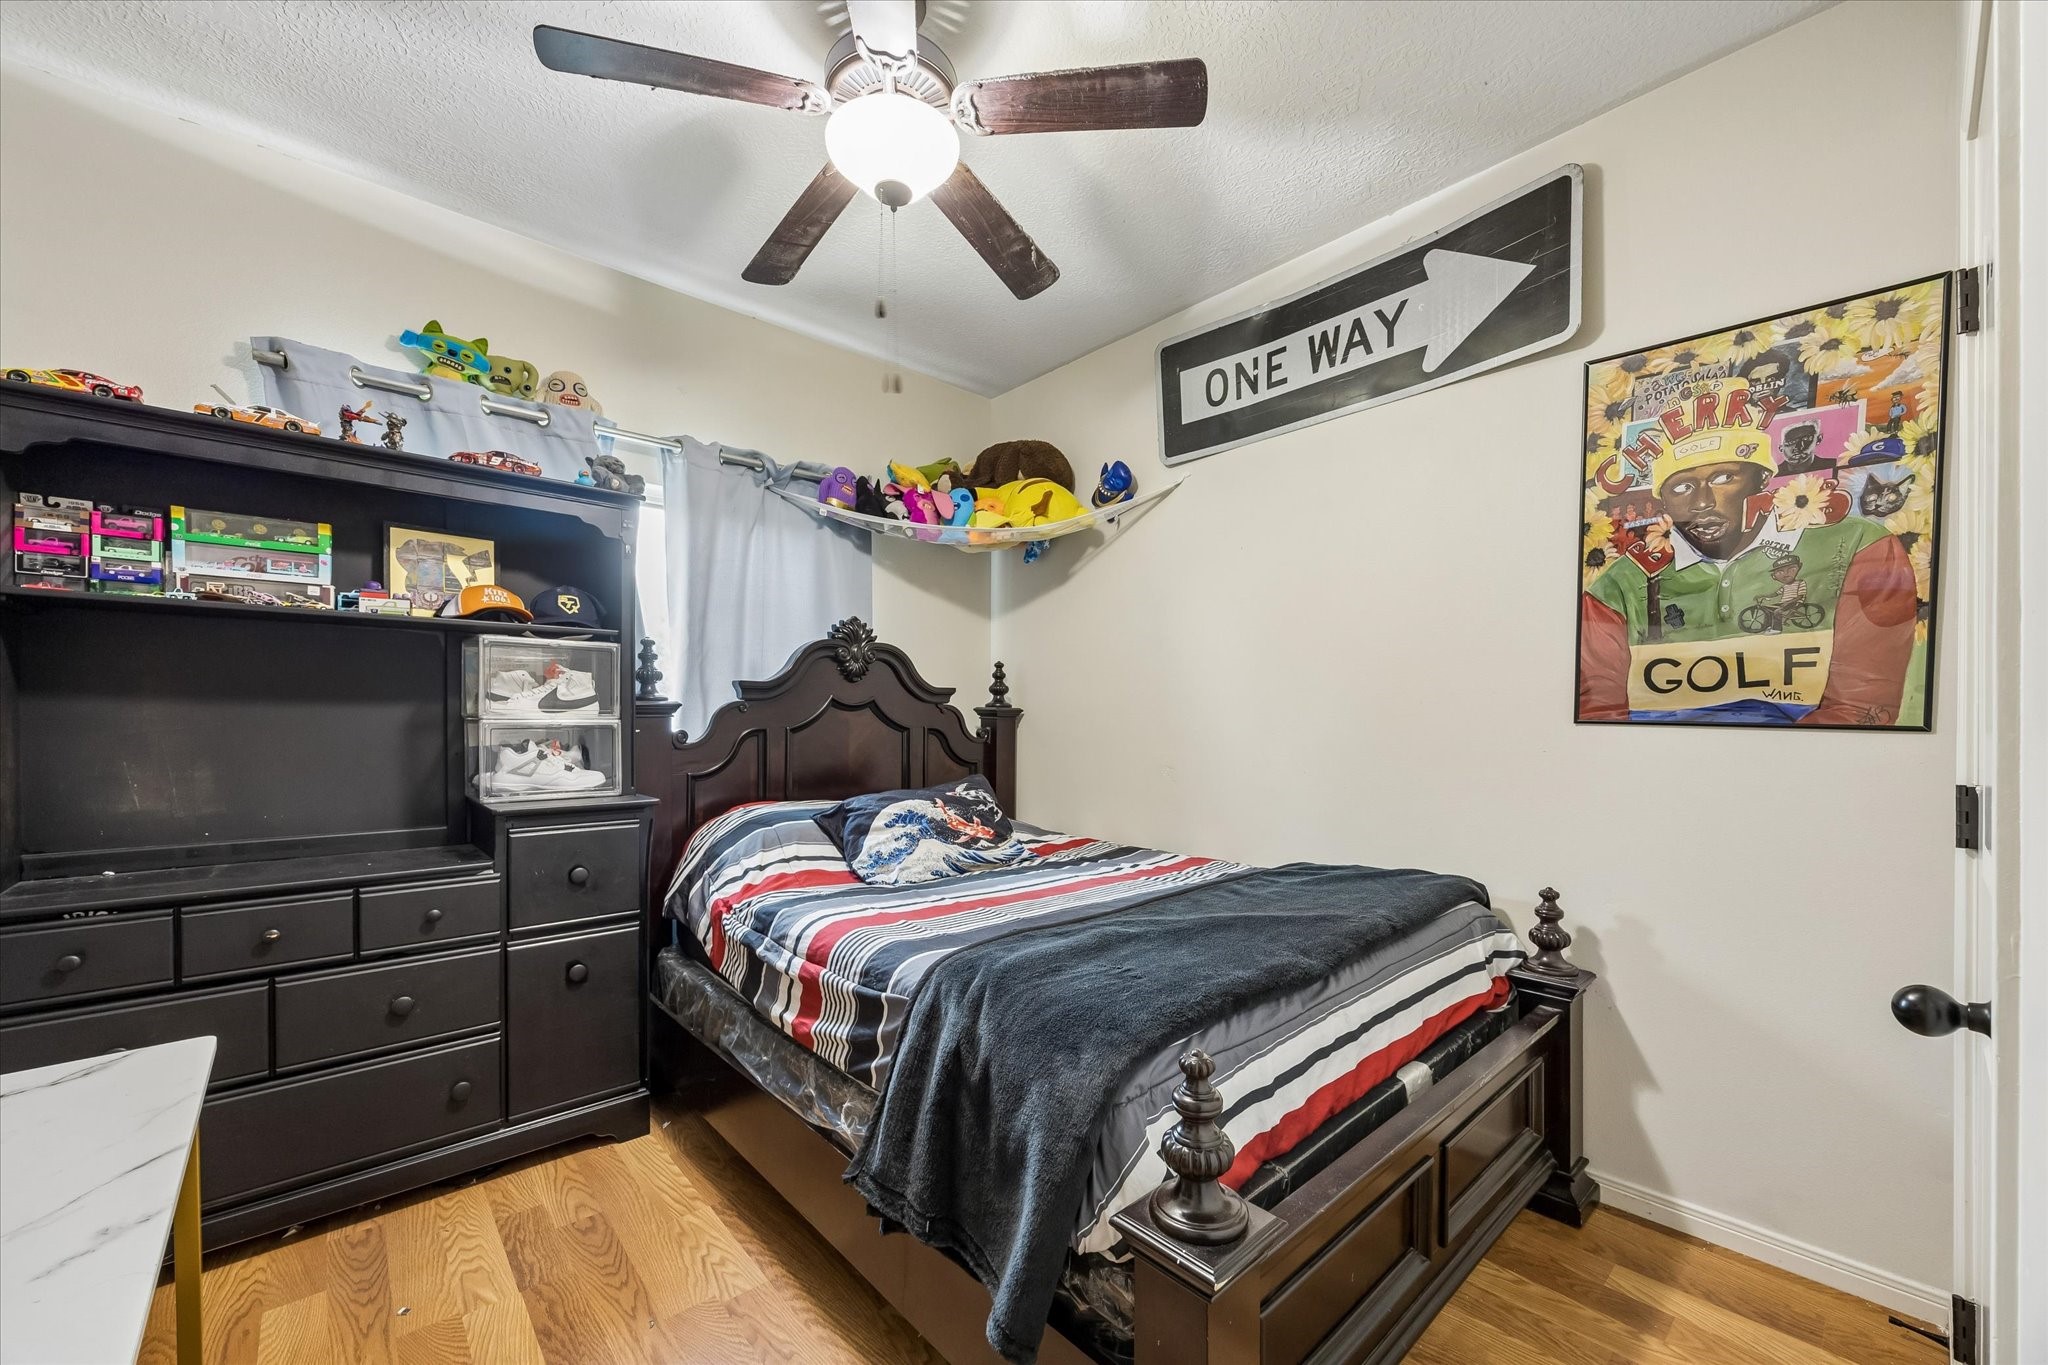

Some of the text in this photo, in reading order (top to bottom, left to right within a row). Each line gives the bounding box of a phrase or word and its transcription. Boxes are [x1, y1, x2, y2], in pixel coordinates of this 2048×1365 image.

[1205, 298, 1409, 407] ONE WAY
[1749, 377, 1785, 393] OBLIN
[253, 411, 268, 423] 7
[1595, 388, 1790, 495] CHERRY
[1679, 440, 1715, 454] GOLF
[1872, 441, 1884, 451] G
[134, 510, 162, 518] Dodge
[1759, 539, 1791, 551] LOITER
[1643, 647, 1820, 694] GOLF
